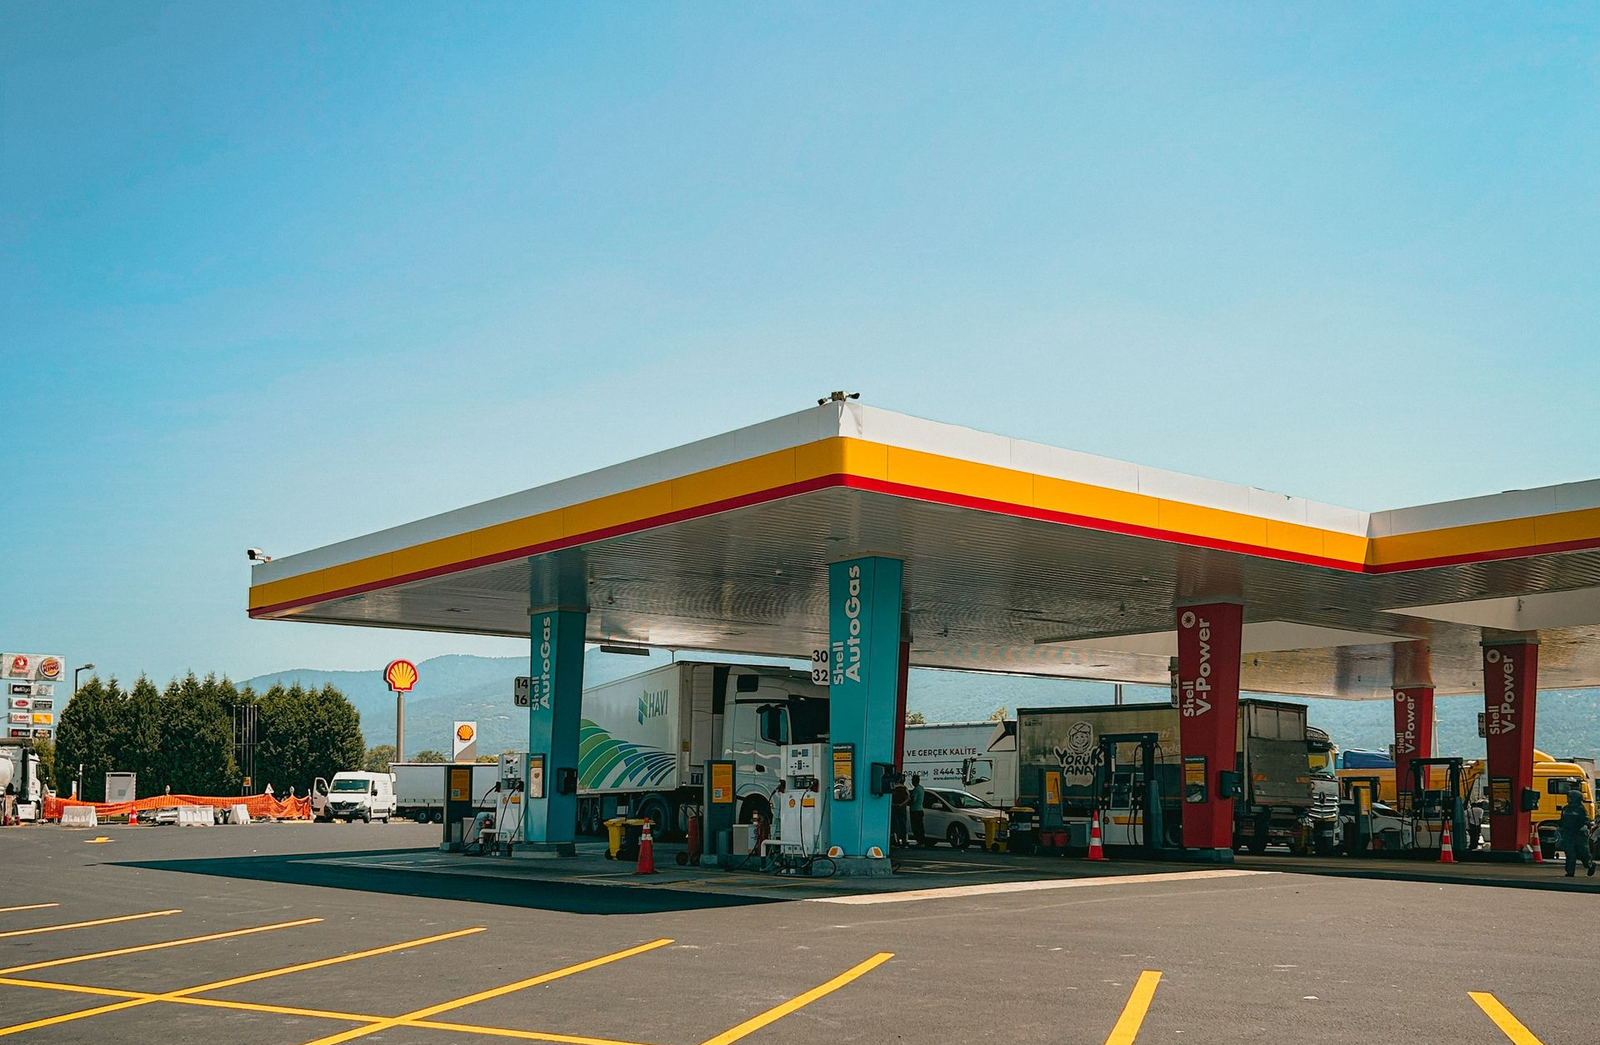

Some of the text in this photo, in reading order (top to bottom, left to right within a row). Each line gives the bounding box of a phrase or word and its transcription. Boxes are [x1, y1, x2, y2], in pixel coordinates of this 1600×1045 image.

[845, 565, 861, 683] AutoGas
[43, 664, 59, 672] KING
[540, 616, 551, 709] AutoGas
[812, 649, 828, 663] 30
[832, 641, 844, 685] Shell
[1195, 618, 1211, 716] V-Power
[516, 679, 529, 689] 14
[812, 668, 828, 682] 32
[515, 695, 528, 705] 16
[532, 676, 540, 711] Shell
[648, 689, 669, 718] HAVI
[1182, 680, 1195, 717] Shell
[1501, 655, 1516, 734] V-Power
[1405, 696, 1415, 754] V-Power
[1488, 705, 1500, 735] Shell
[918, 748, 948, 758] GERÇEK
[949, 746, 976, 755] KALİTE
[1055, 748, 1103, 765] YÖRÜK
[1396, 732, 1405, 754] Shell
[1065, 765, 1094, 776] ANA
